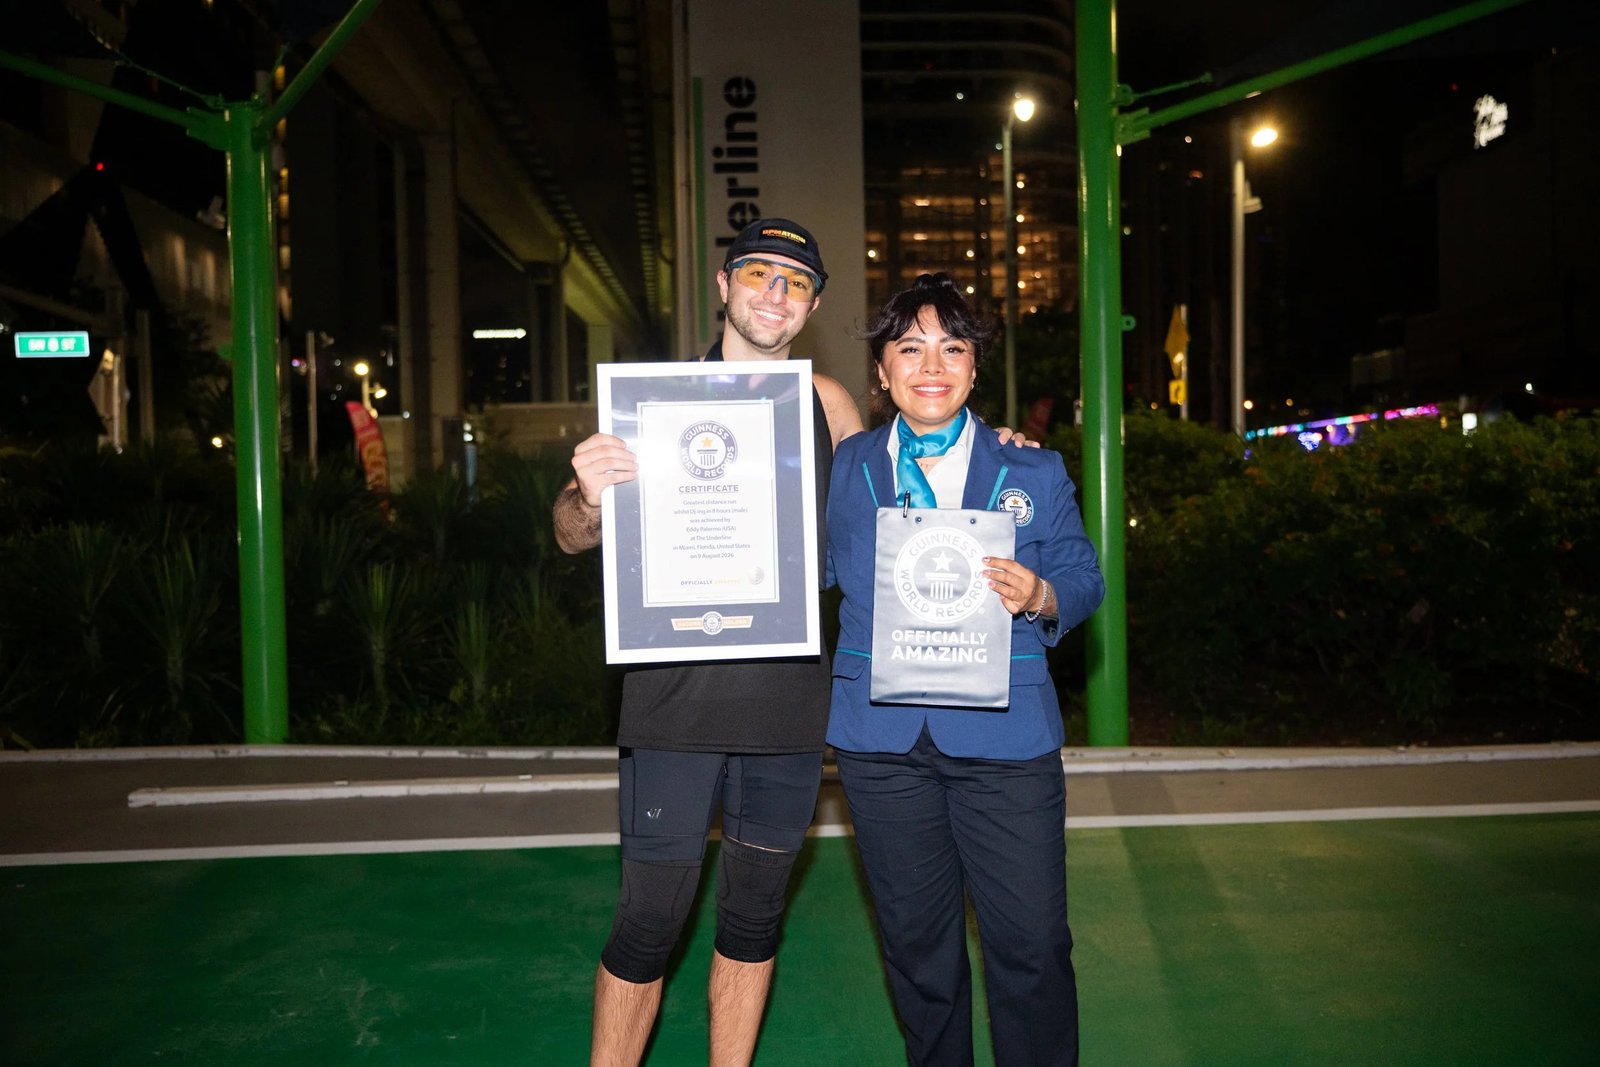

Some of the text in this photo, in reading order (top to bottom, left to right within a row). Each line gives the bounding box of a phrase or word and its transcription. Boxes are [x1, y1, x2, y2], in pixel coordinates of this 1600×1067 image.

[685, 423, 730, 441] GUINNESS
[680, 447, 702, 476] WORLD
[704, 445, 735, 478] RECORDS
[678, 484, 739, 493] CERTIFICATE
[1001, 491, 1029, 502] GUINNESS
[909, 532, 978, 559] GUINNESS
[900, 569, 930, 614] WORLD
[935, 570, 984, 618] RECORDS
[891, 629, 989, 646] OFFICIALLY
[890, 645, 989, 664] AMAZING
